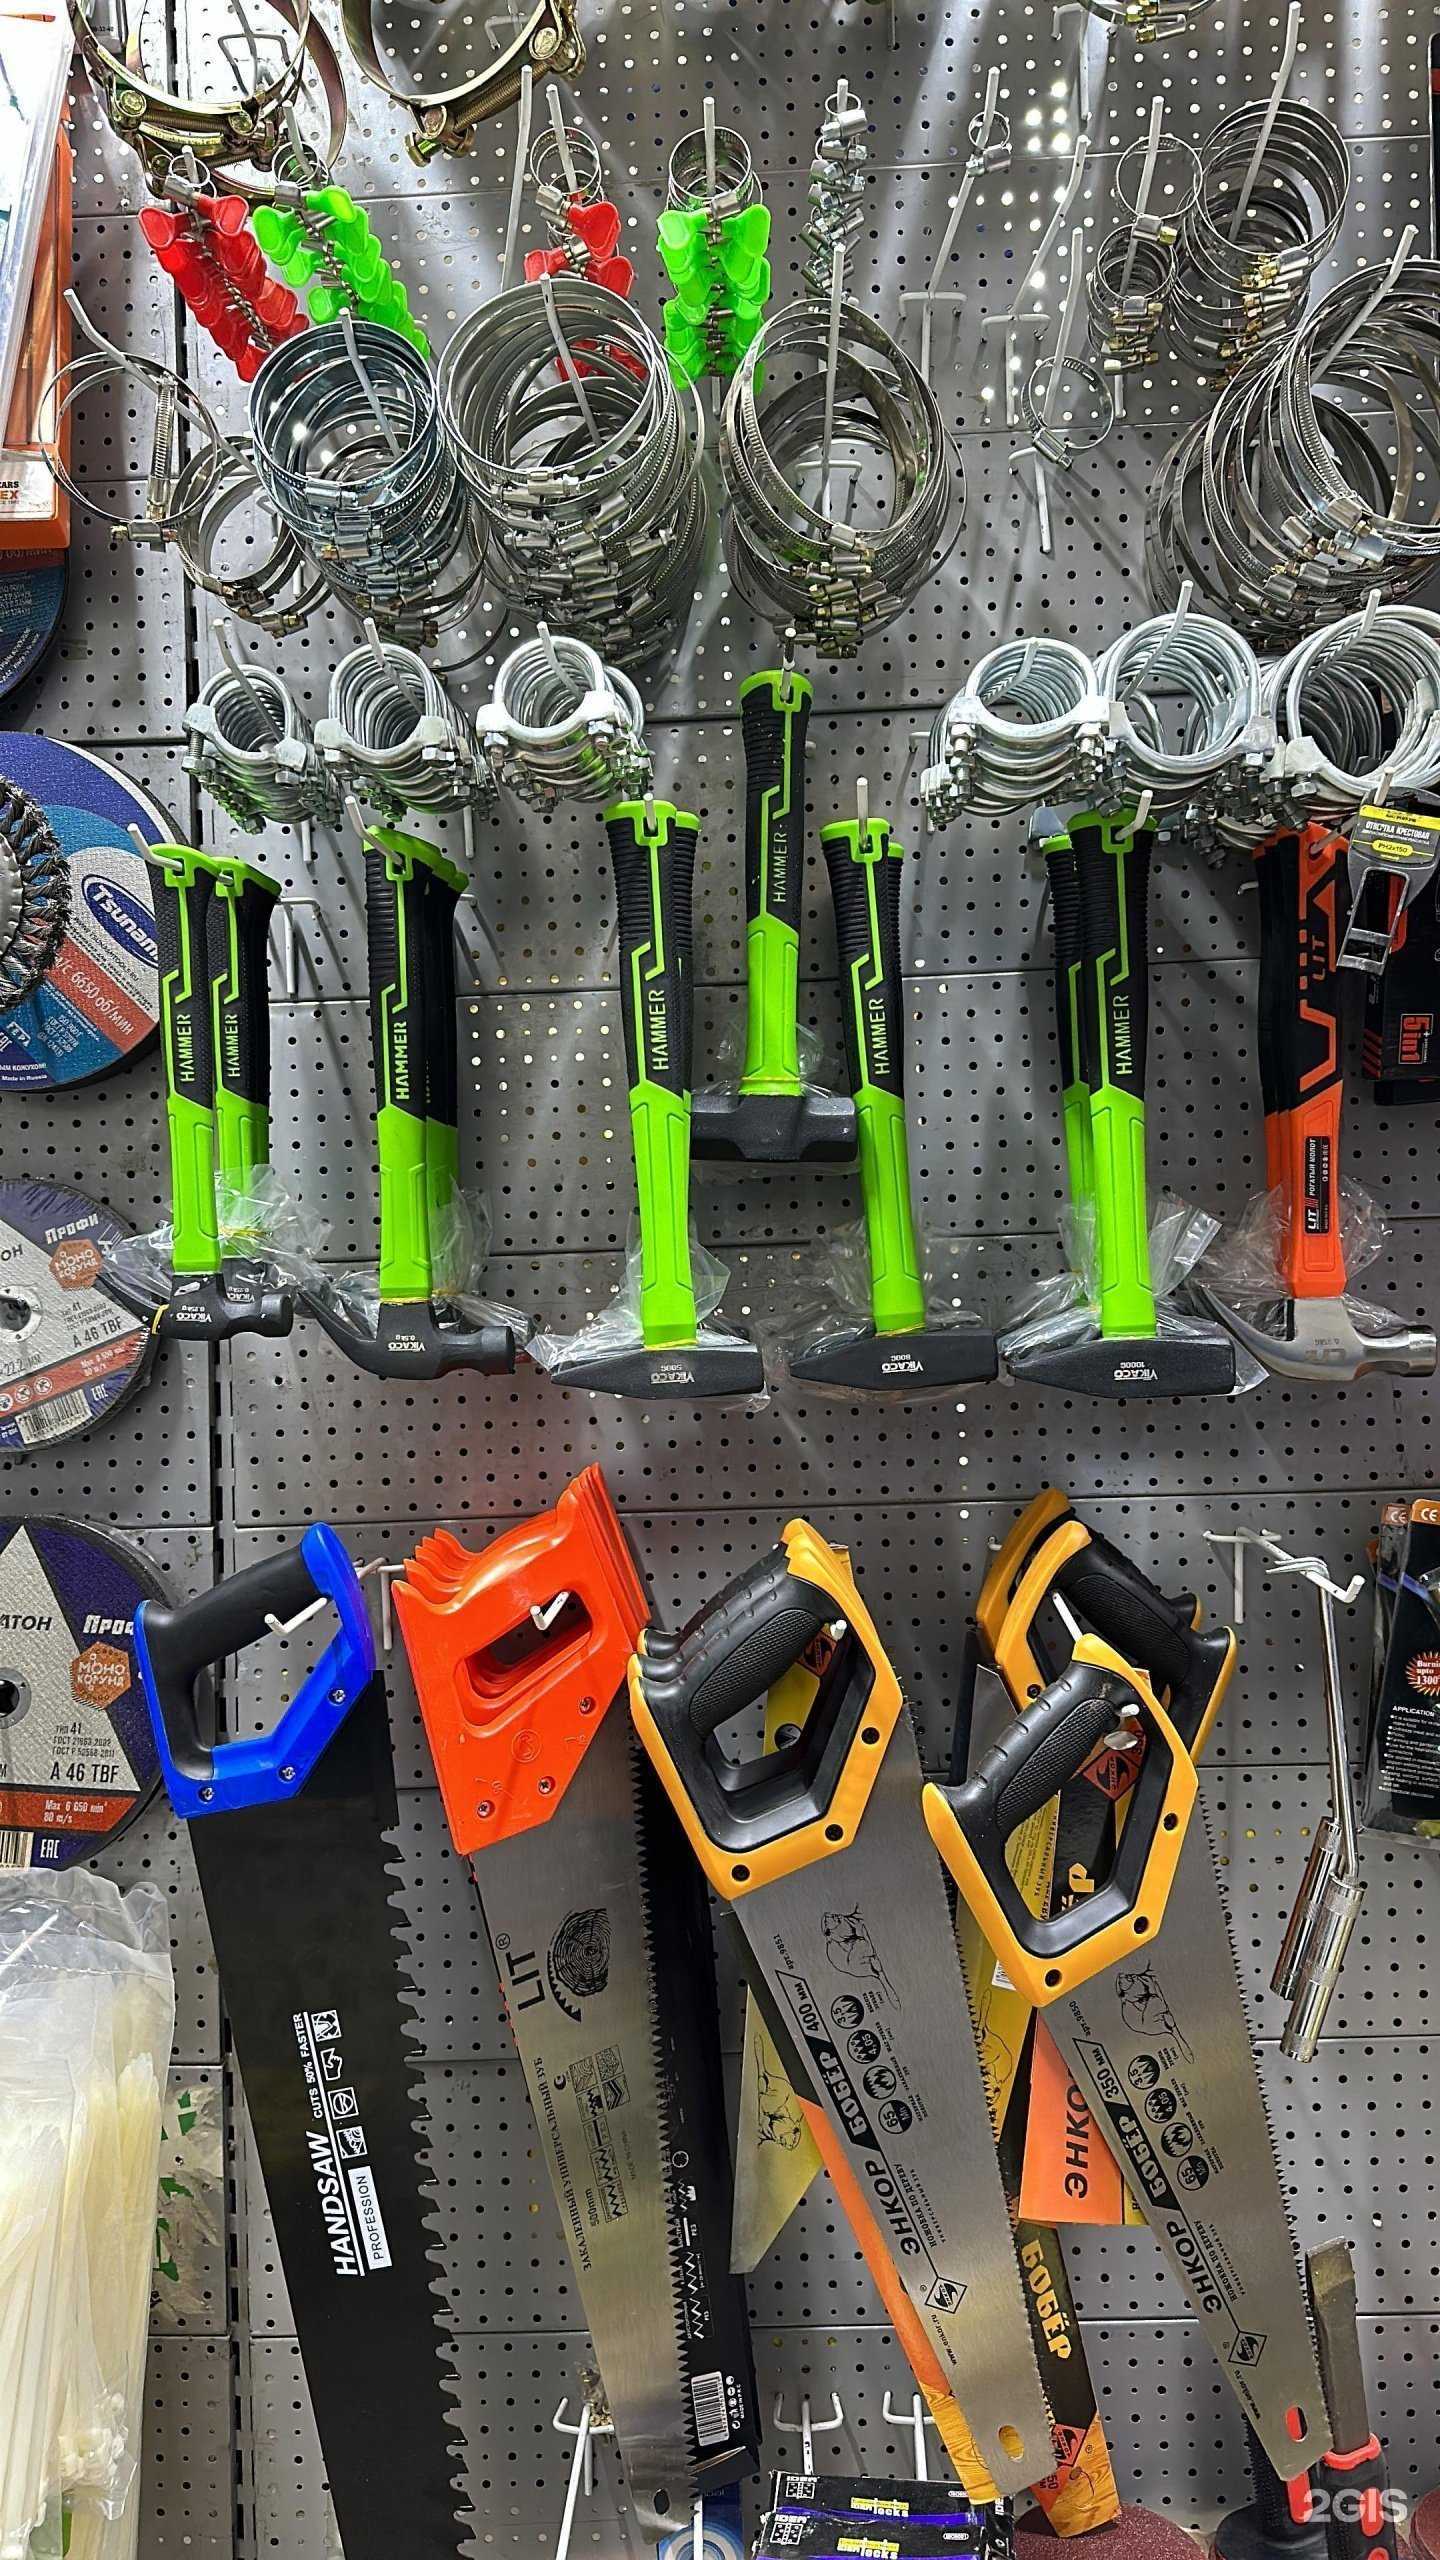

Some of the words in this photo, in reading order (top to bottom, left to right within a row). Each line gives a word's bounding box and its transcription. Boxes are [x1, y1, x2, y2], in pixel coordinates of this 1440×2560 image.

[772, 832, 788, 902] HAMMER
[93, 884, 159, 961] Tsunam
[1311, 934, 1326, 981] LIT
[177, 1014, 195, 1082] HAMMER
[224, 1014, 241, 1077] HAMMER
[648, 989, 669, 1071] HAMMER
[868, 998, 891, 1075] HAMMER
[1112, 995, 1133, 1075] HAMMER
[393, 1021, 410, 1100] HAMMER
[1308, 1209, 1317, 1230] LIT
[72, 1334, 82, 1348] A
[85, 1327, 99, 1342] 46
[101, 1316, 121, 1335] TBF
[176, 1312, 212, 1323] VIKACO
[388, 1342, 426, 1352] VIKACO
[650, 1372, 695, 1384] VIKACO
[881, 1360, 924, 1374] VIKACO
[1113, 1368, 1159, 1381] VIKACO
[77, 1673, 125, 1688] КОРУНД
[79, 1661, 126, 1676] МОНО
[70, 1722, 82, 1735] 41
[1392, 1705, 1435, 1718] APPLICATION
[50, 1761, 60, 1781] A
[66, 1762, 85, 1782] 46
[92, 1764, 119, 1784] TBF
[45, 1800, 61, 1811] Max
[506, 1951, 545, 2011] LIT
[292, 2013, 310, 2058] FASTER
[800, 2003, 819, 2032] 400
[304, 2061, 316, 2084] 50%
[1097, 2067, 1119, 2099] 350
[309, 2088, 323, 2119] CUTS
[819, 2050, 868, 2137] БОБЁР
[883, 2108, 898, 2127] 65
[1064, 2070, 1089, 2199] ЭНКО
[1119, 2115, 1167, 2198] БОБЁР
[894, 2163, 915, 2196] ДЕРЕВУ
[1181, 2167, 1197, 2185] 65
[306, 2131, 359, 2276] HANDSAW
[356, 2175, 384, 2260] PROFESSION
[865, 2160, 921, 2256] ЭНКОР
[563, 2188, 592, 2272] ЗАКАЛЕННЫЙ
[914, 2210, 938, 2249] НОЖОВКА
[1194, 2220, 1214, 2250] ДЕРЕВУ
[1166, 2220, 1222, 2314] ЭНКОР
[1214, 2263, 1238, 2301] НОЖОВКА
[1021, 2239, 1072, 2360] БОБЁР
[931, 2314, 957, 2366] www.enkor.ru
[1045, 2474, 1058, 2490] 50
